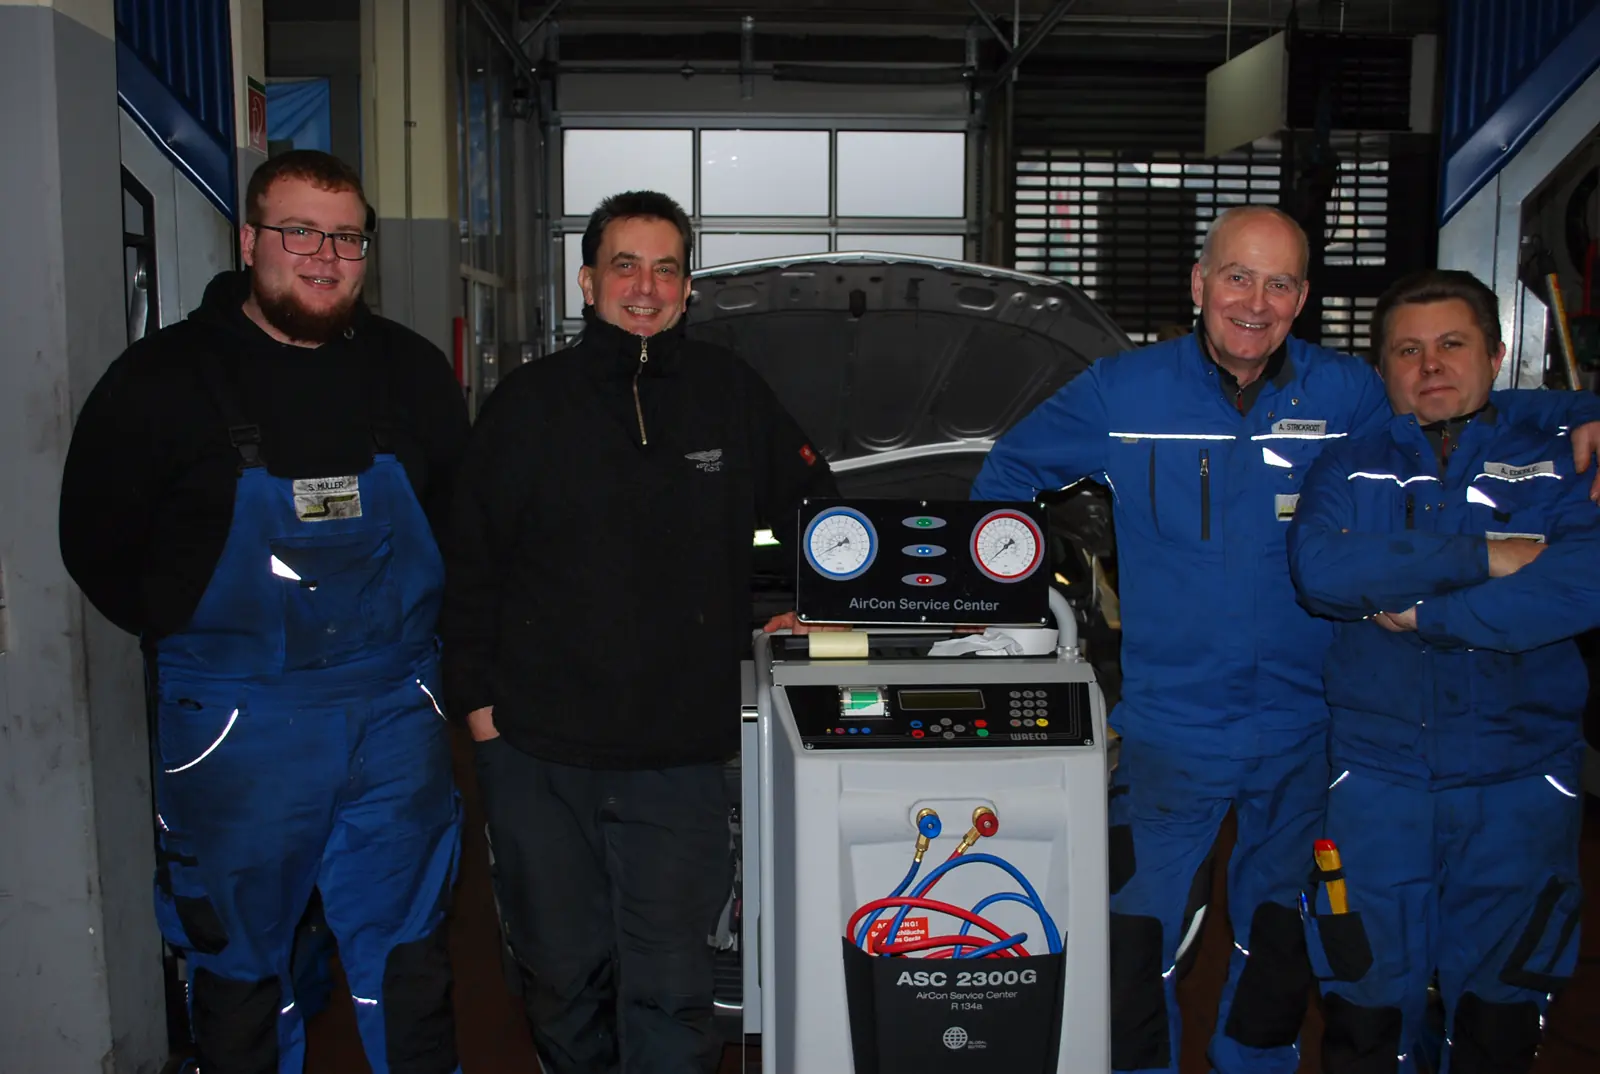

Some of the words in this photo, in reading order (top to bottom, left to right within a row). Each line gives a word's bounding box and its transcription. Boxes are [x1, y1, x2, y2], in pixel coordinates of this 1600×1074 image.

[849, 597, 896, 609] AirCon
[899, 598, 950, 610] Service
[953, 599, 999, 611] Center
[1010, 732, 1048, 741] WAECO
[896, 971, 948, 987] ASC
[955, 969, 1037, 987] 2300G
[916, 992, 948, 1000] AirCon
[949, 991, 984, 1000] Service
[985, 990, 1018, 999] Center
[950, 1002, 959, 1010] R
[960, 1002, 983, 1010] 134a
